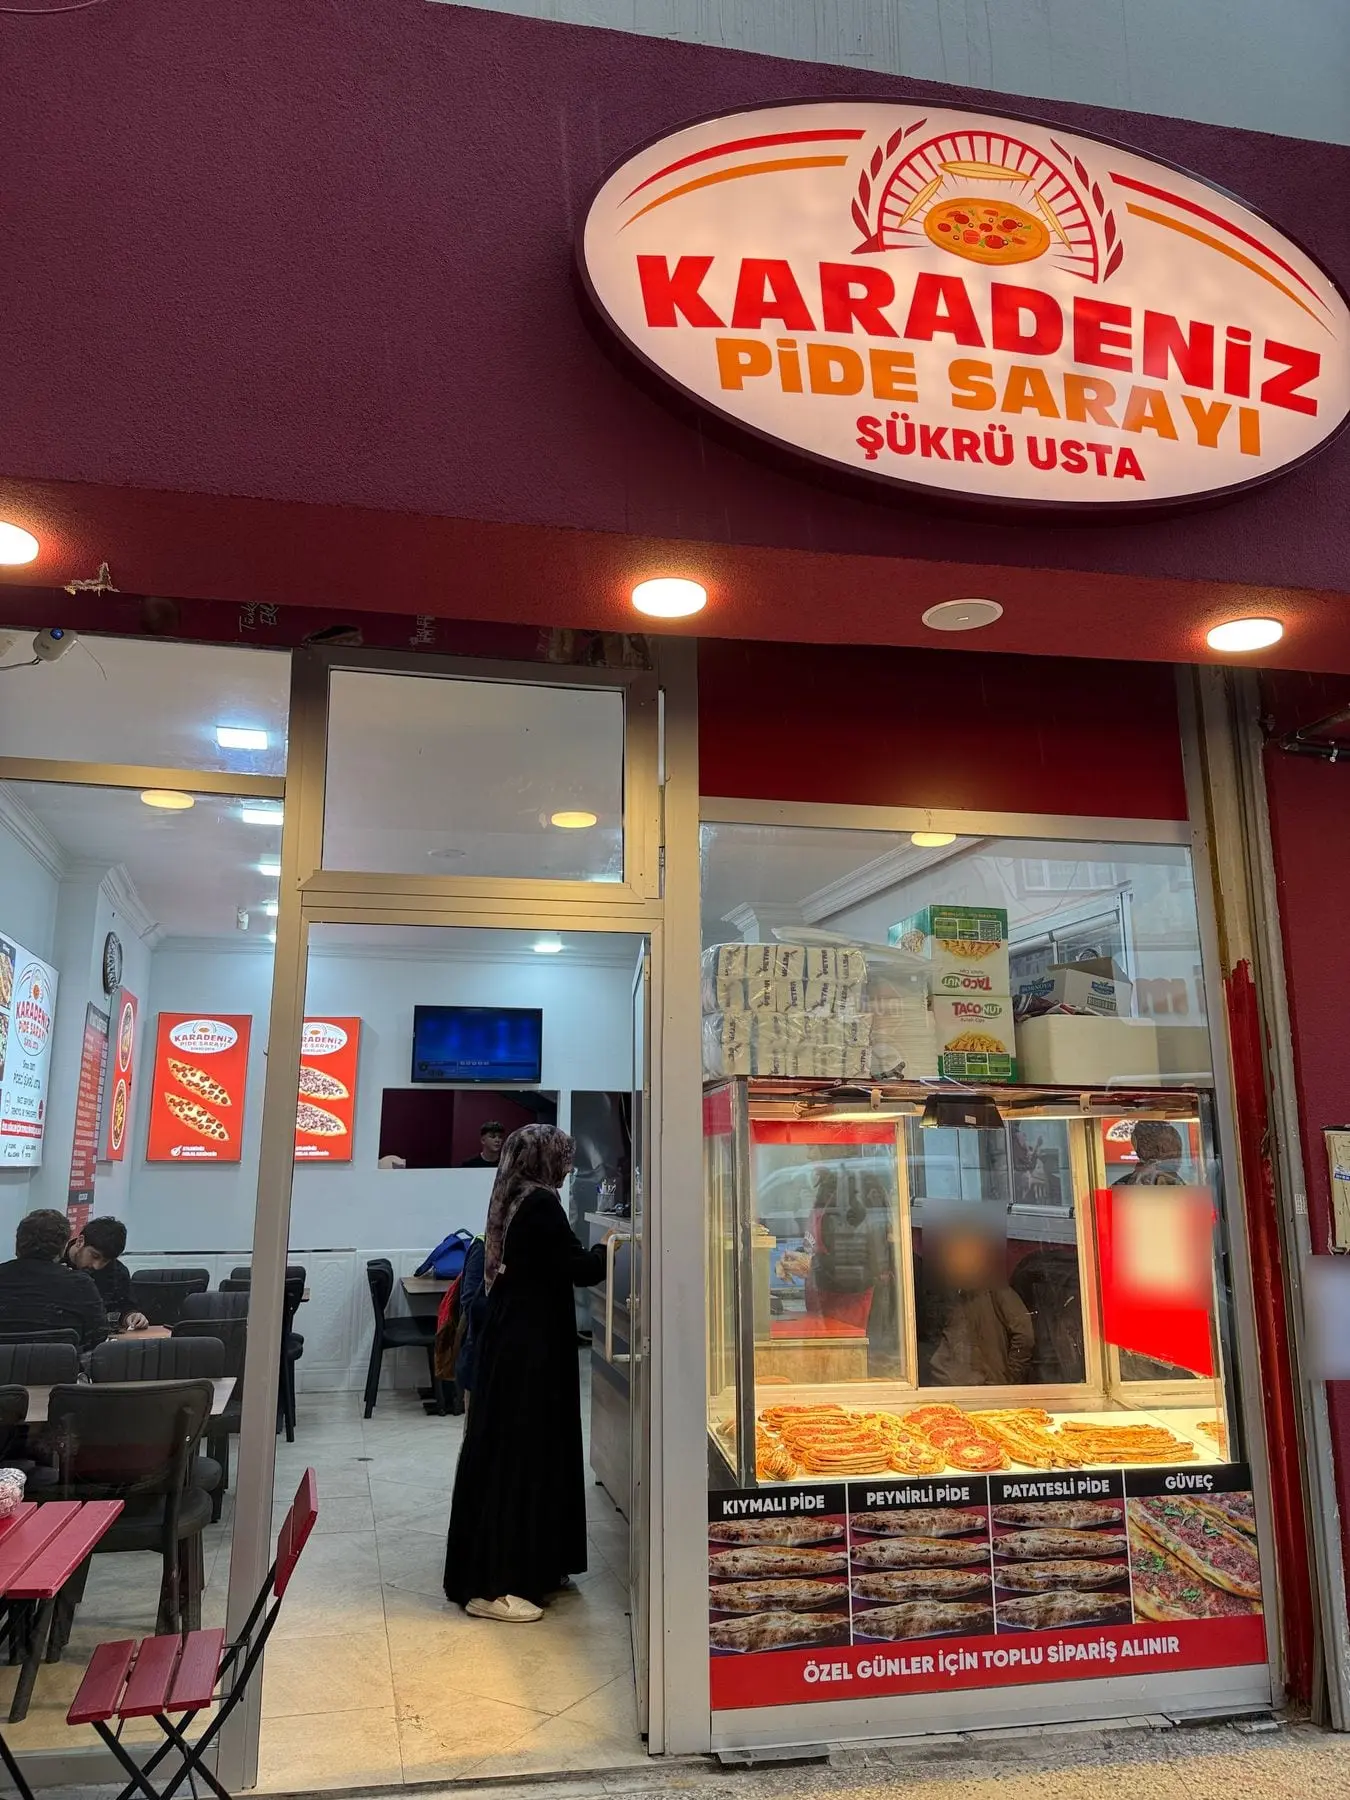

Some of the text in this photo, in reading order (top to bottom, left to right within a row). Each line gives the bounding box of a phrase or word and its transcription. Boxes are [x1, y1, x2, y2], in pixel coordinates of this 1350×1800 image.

[948, 359, 1262, 456] SARAYI
[855, 411, 1146, 482] ŞÜKRÜ USTA
[962, 976, 992, 991] TACO
[952, 1002, 982, 1016] TACO
[1003, 1477, 1110, 1498] PATATESLİ PİDE
[1165, 1473, 1214, 1491] GÜVEÇ
[723, 1492, 825, 1515] KIYMALI PİDE
[866, 1484, 970, 1506] PEYNİRLİ PİDE
[803, 1636, 1180, 1683] ÖZEL GÜNLER İÇİN TOPLU SİPARİŞ ALINIR
